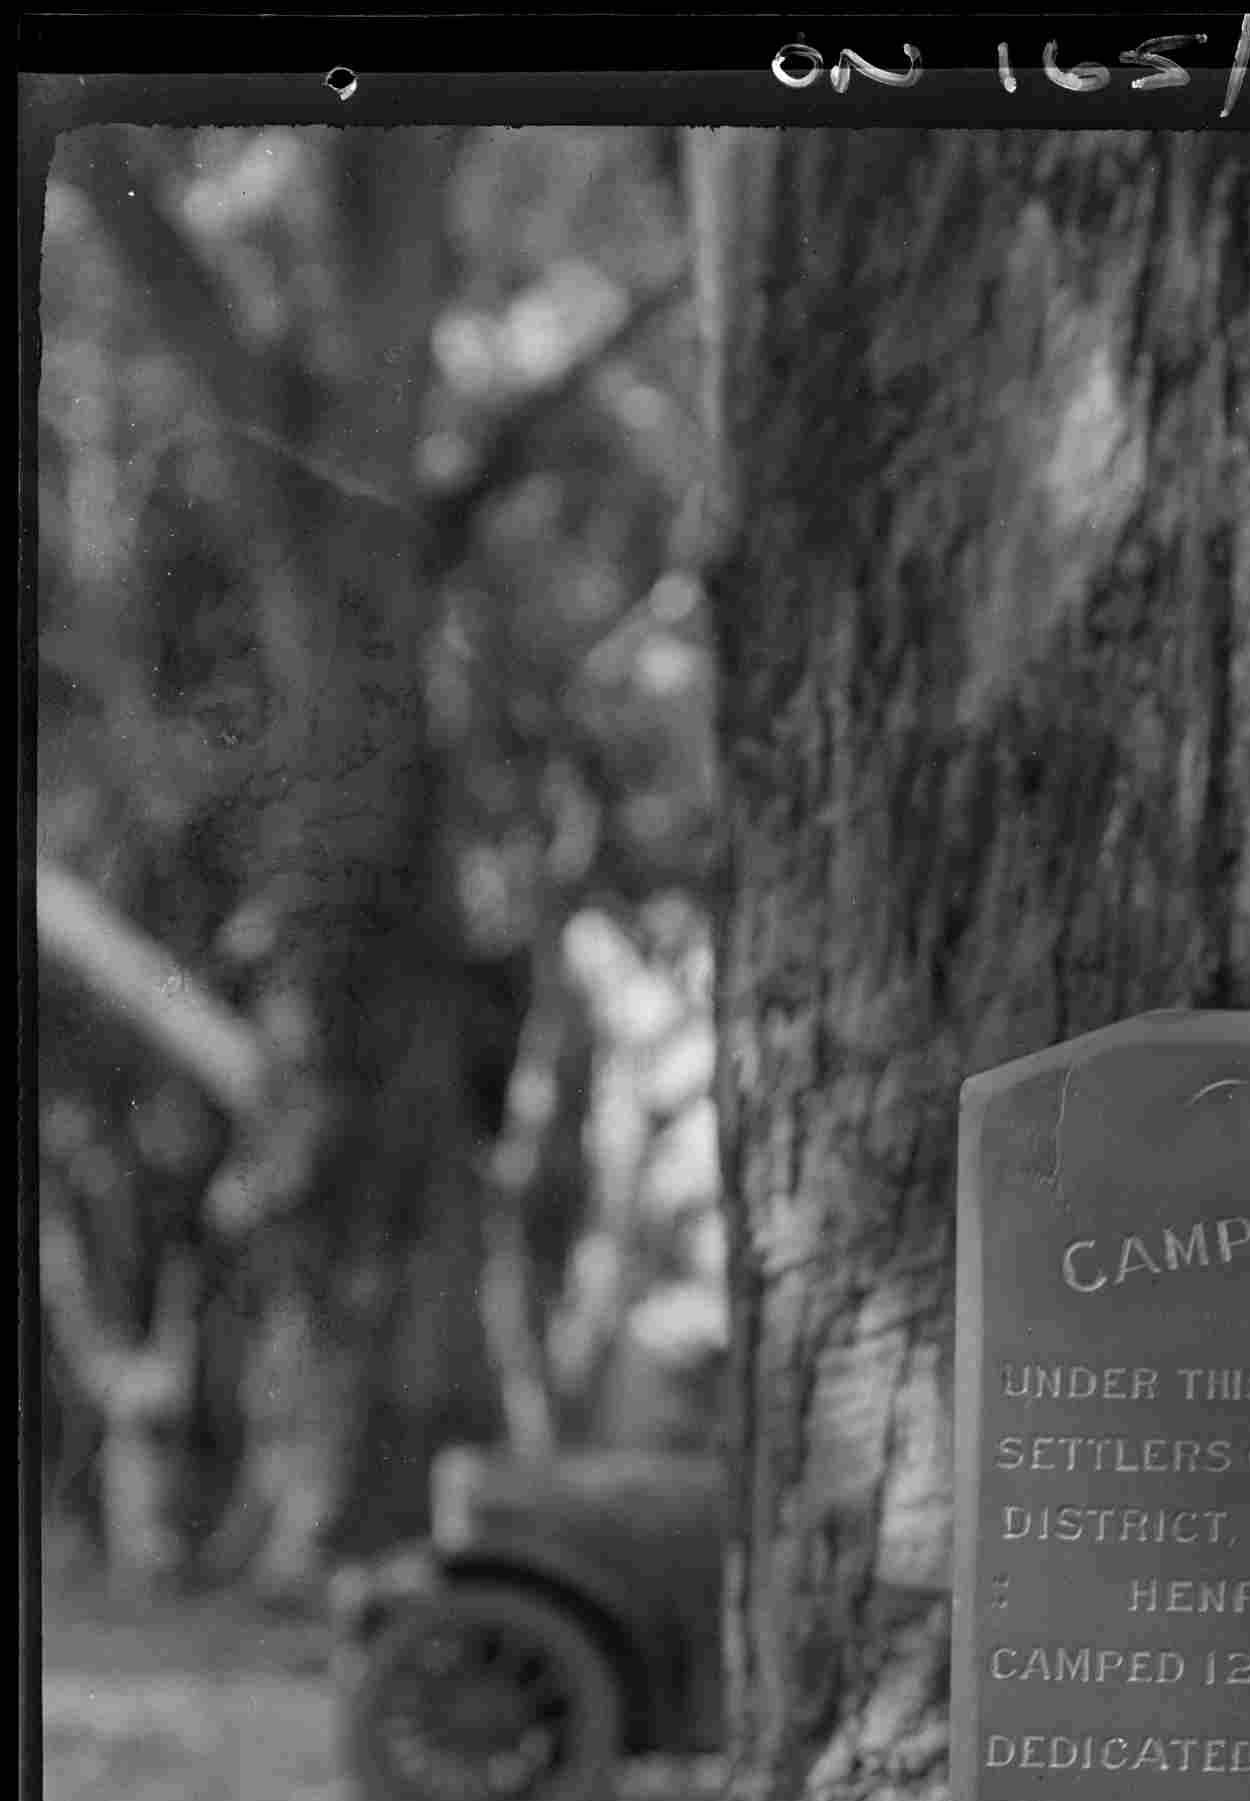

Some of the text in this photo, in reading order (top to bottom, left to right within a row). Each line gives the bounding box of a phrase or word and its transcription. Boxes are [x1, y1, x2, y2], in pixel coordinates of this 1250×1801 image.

[773, 40, 924, 94] ON
[1002, 1364, 1159, 1400] UNDER
[996, 1436, 1232, 1473] SETTLERS
[991, 1647, 1186, 1684] CAMPED
